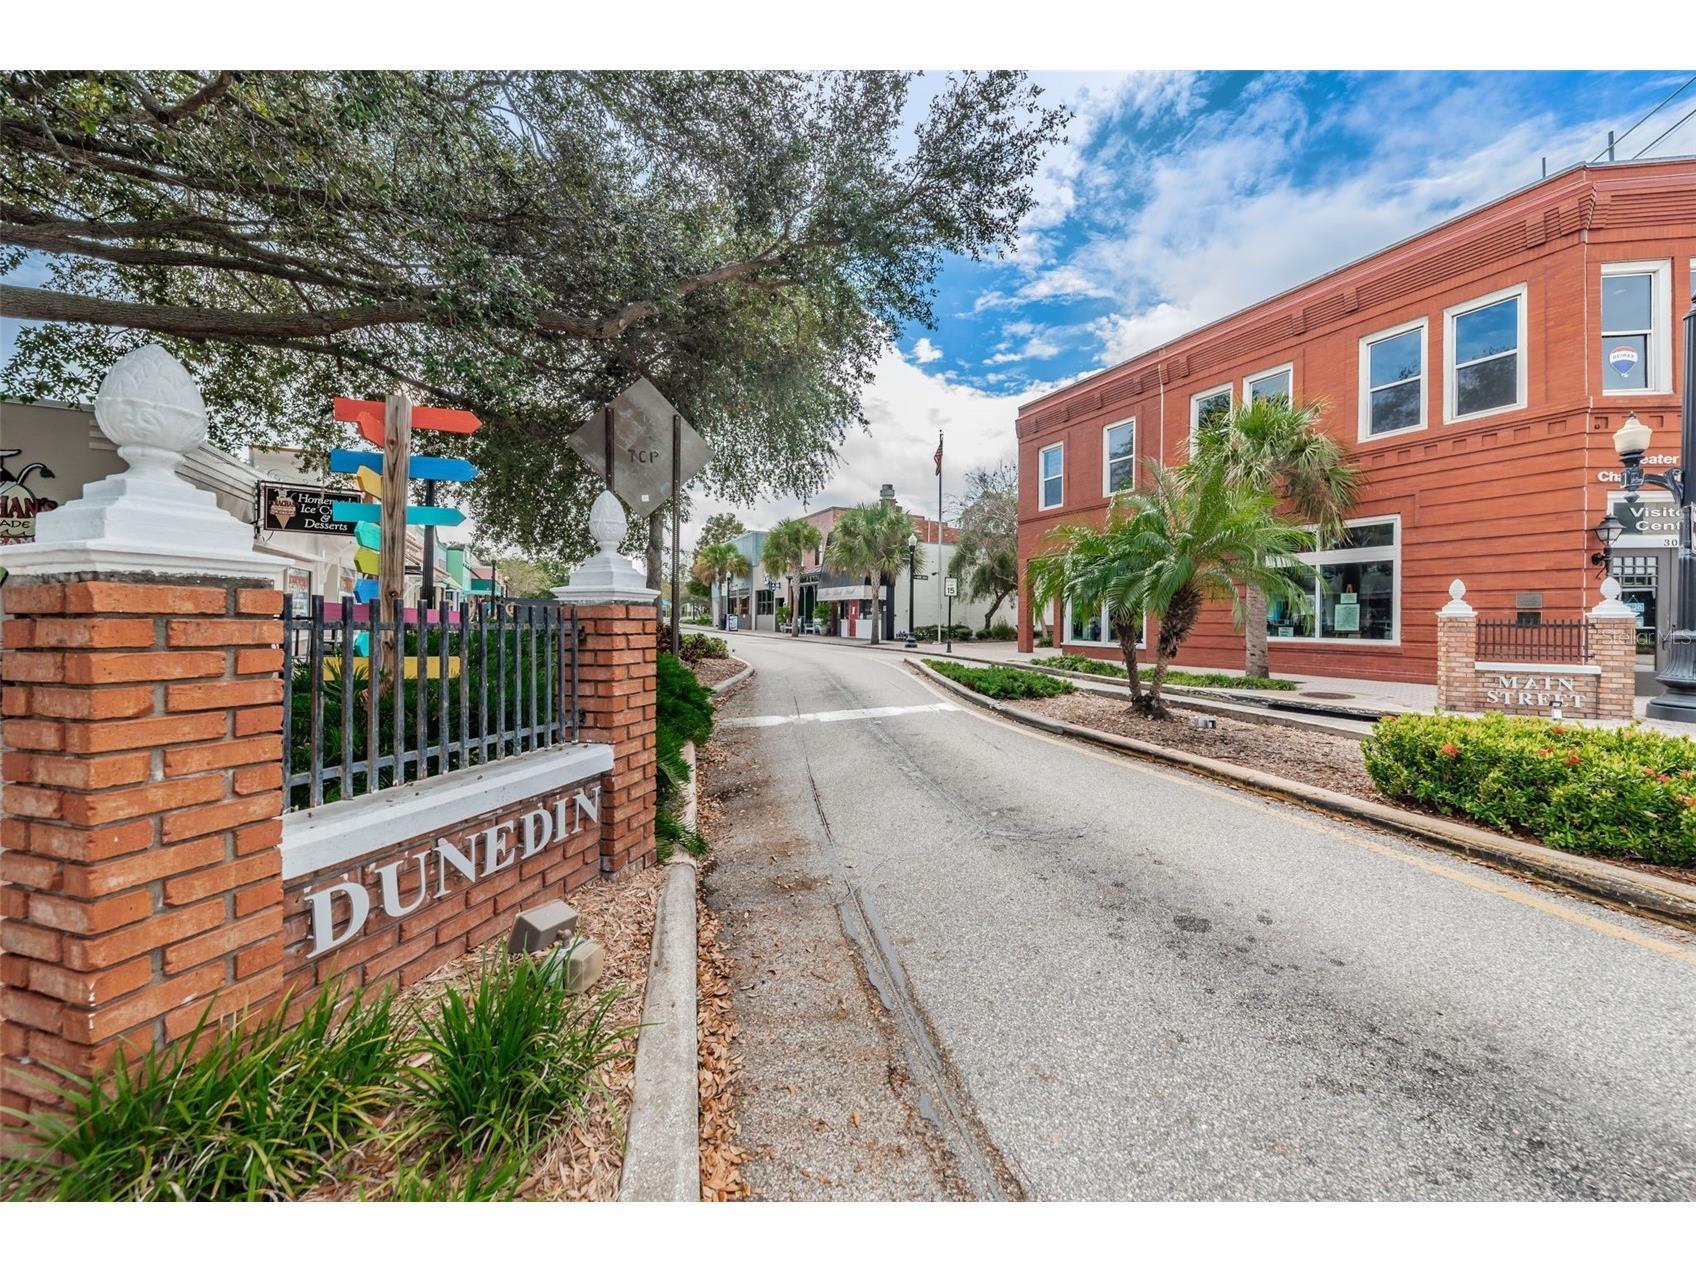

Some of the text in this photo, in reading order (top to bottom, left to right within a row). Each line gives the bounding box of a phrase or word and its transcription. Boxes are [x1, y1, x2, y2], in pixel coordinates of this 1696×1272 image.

[627, 449, 659, 463] TCP
[1639, 454, 1680, 464] eater
[300, 504, 317, 514] Ice
[0, 520, 31, 528] ADE
[320, 514, 331, 523] &
[304, 519, 348, 531] Desserts
[1635, 521, 1680, 531] Cent
[1498, 675, 1575, 691] MAIN
[1486, 690, 1586, 708] STREET
[303, 786, 602, 958] DUNEDIN
